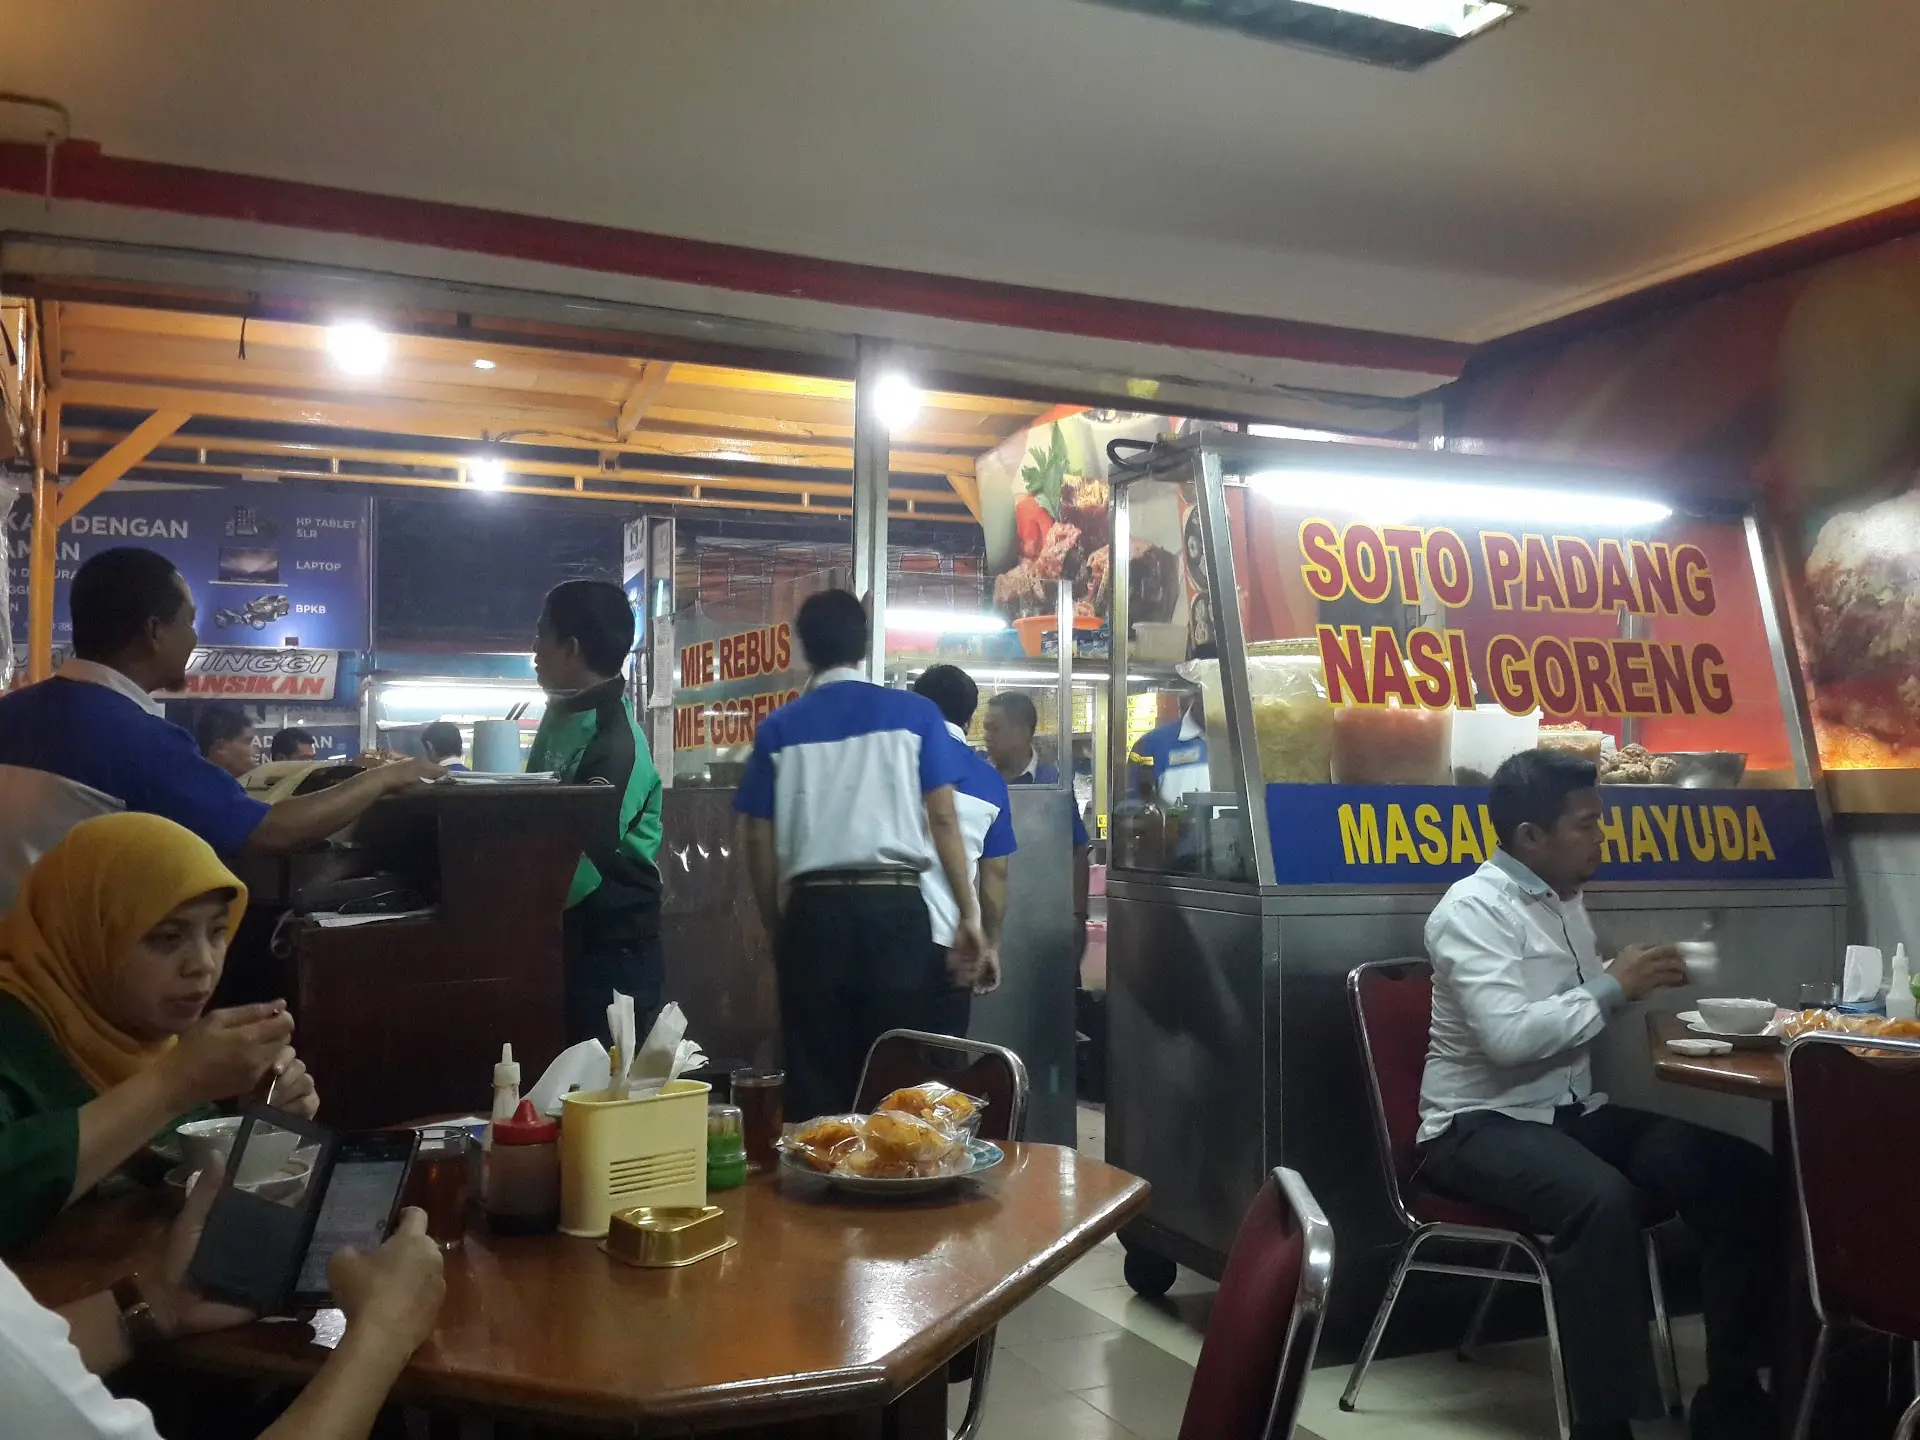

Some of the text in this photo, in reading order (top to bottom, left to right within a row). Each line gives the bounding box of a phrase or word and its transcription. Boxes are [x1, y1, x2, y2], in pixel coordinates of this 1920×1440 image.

[70, 515, 188, 538] DENGAN
[296, 518, 357, 529] HP TABLET
[296, 529, 318, 538] SLR
[296, 560, 341, 571] LAPTOP
[1298, 518, 1717, 617] SOTO PADANG
[295, 604, 326, 614] BPKB
[184, 651, 328, 674] TINGGI
[680, 640, 714, 689] MIE
[719, 622, 792, 682] REBUS
[1316, 624, 1735, 718] NASI GORENG
[674, 702, 705, 751] MIE
